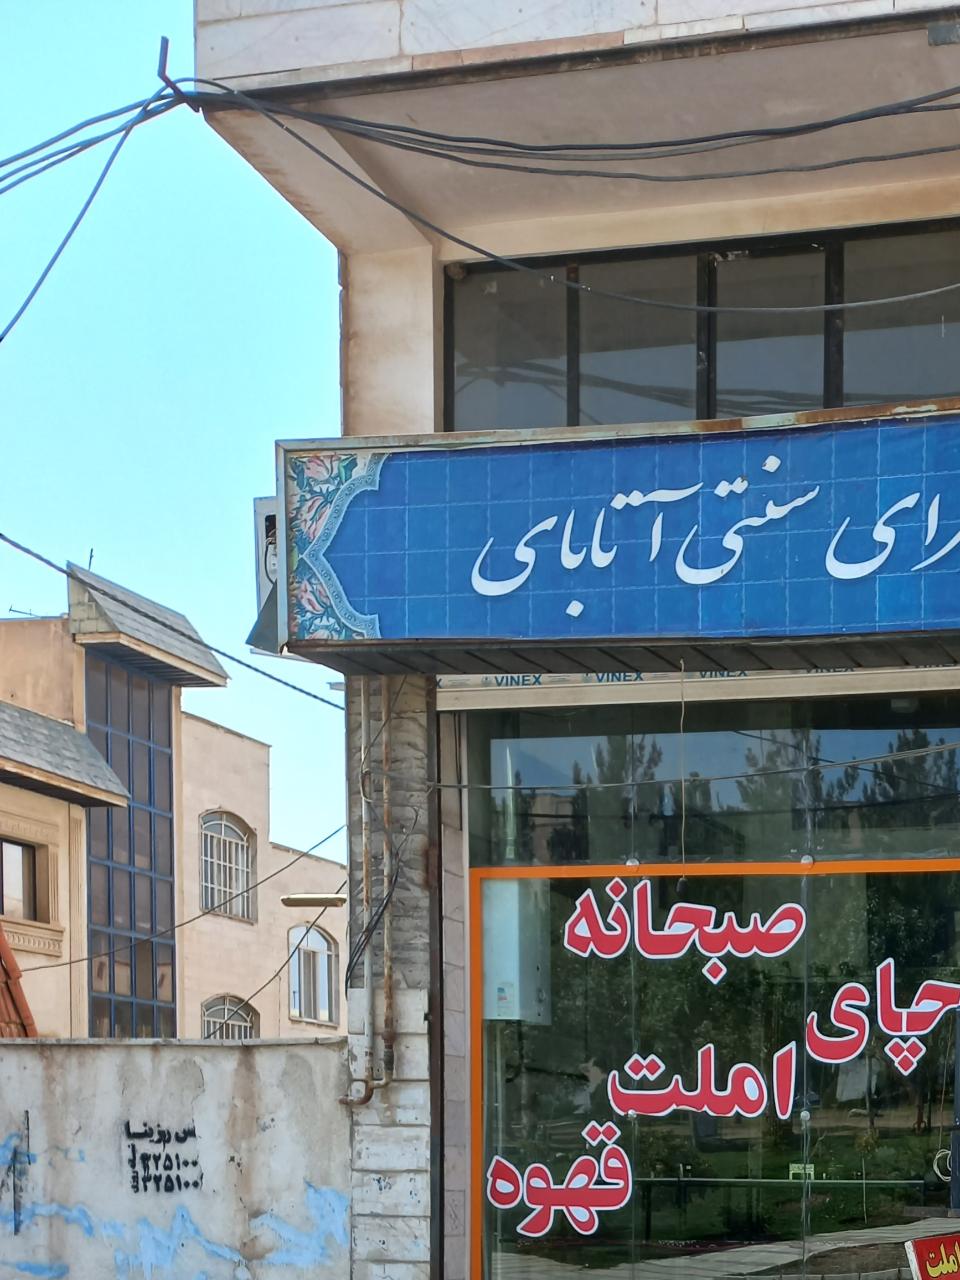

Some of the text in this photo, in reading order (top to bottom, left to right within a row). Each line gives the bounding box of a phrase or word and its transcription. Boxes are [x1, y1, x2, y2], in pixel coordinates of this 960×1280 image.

[471, 482, 704, 617] آتابای
[675, 455, 820, 585] سنتی
[495, 674, 542, 687] VINEX
[595, 671, 644, 682] VINEX
[564, 877, 807, 985] صبحانه
[607, 1041, 797, 1120] املت
[487, 1121, 633, 1238] قهوه
